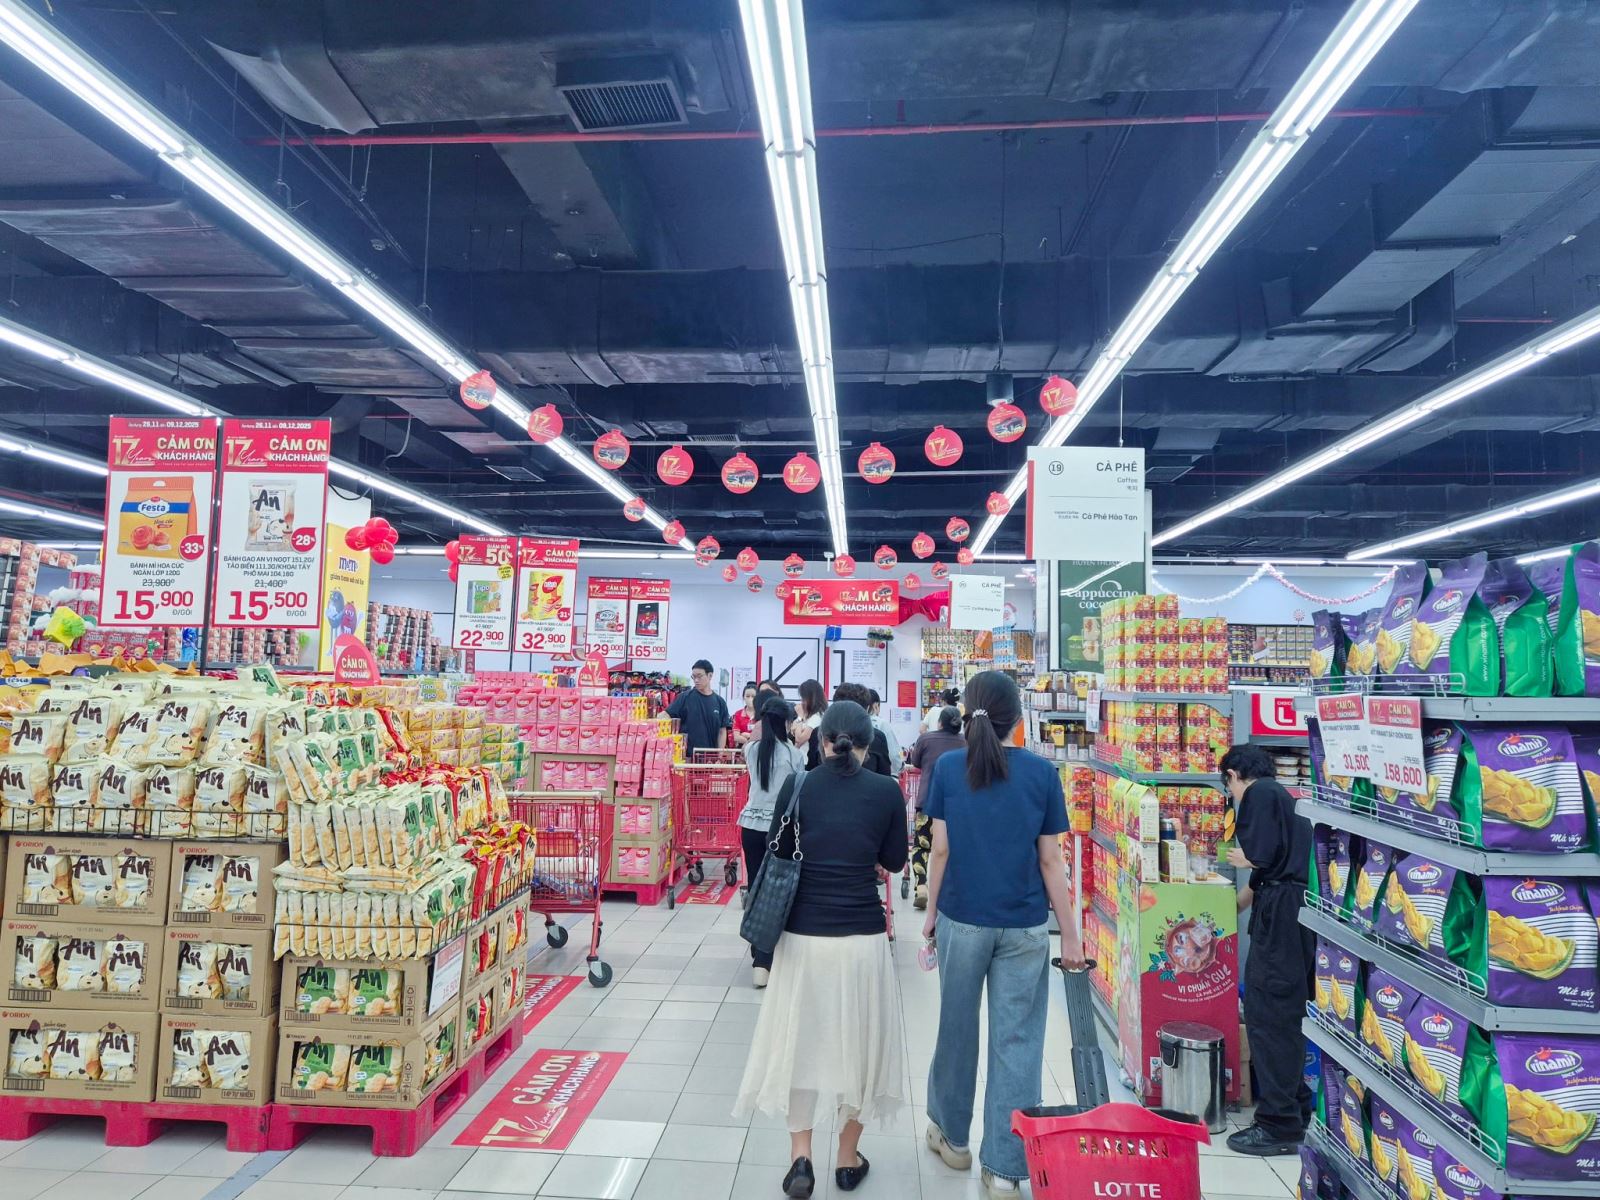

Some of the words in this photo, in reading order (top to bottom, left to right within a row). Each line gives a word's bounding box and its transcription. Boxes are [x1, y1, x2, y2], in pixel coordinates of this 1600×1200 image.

[112, 438, 141, 466] 17
[157, 434, 190, 450] CẢM
[193, 437, 215, 450] ƠN
[226, 438, 253, 466] 17
[269, 434, 303, 451] CẢM
[305, 438, 327, 451] ƠN
[928, 439, 946, 458] 17
[157, 450, 188, 461] KHÁCH
[189, 450, 214, 461] HÀNG
[269, 451, 301, 462] KHÁCH
[302, 451, 327, 462] HÀNG
[662, 457, 680, 474] 17
[1096, 460, 1112, 472] CÀ
[1115, 460, 1137, 472] PHÊ
[788, 465, 806, 482] 17
[1051, 464, 1062, 472] 19
[141, 503, 167, 513] Festa
[252, 489, 281, 512] An
[545, 549, 564, 557] CẢM
[114, 590, 194, 620] 15,900
[228, 591, 308, 621] 15,500
[841, 603, 868, 612] KHÁCH
[869, 603, 891, 612] HÀNG
[460, 630, 504, 647] 22,900
[522, 632, 566, 649] 32,900
[341, 657, 358, 669] CẢM
[70, 700, 102, 725] An
[11, 719, 44, 746] An
[1503, 737, 1544, 756] vinamit
[51, 766, 84, 793] An
[100, 765, 127, 795] An
[1384, 762, 1422, 786] 158,600
[73, 855, 107, 879] An
[223, 858, 253, 882] An
[1517, 884, 1558, 901] vinamit
[60, 938, 96, 961] An
[217, 949, 250, 976] An
[299, 966, 329, 990] An
[351, 968, 383, 991] An
[48, 1030, 80, 1058] An
[205, 1035, 241, 1066] An
[1530, 1054, 1576, 1073] vinamit
[512, 1074, 561, 1105] CẢM
[540, 1055, 576, 1073] ƠN
[547, 1076, 585, 1107] KHÁCH
[570, 1056, 600, 1078] HÀNG
[479, 1117, 550, 1145] 17
[1093, 1181, 1162, 1199] LOTTE
